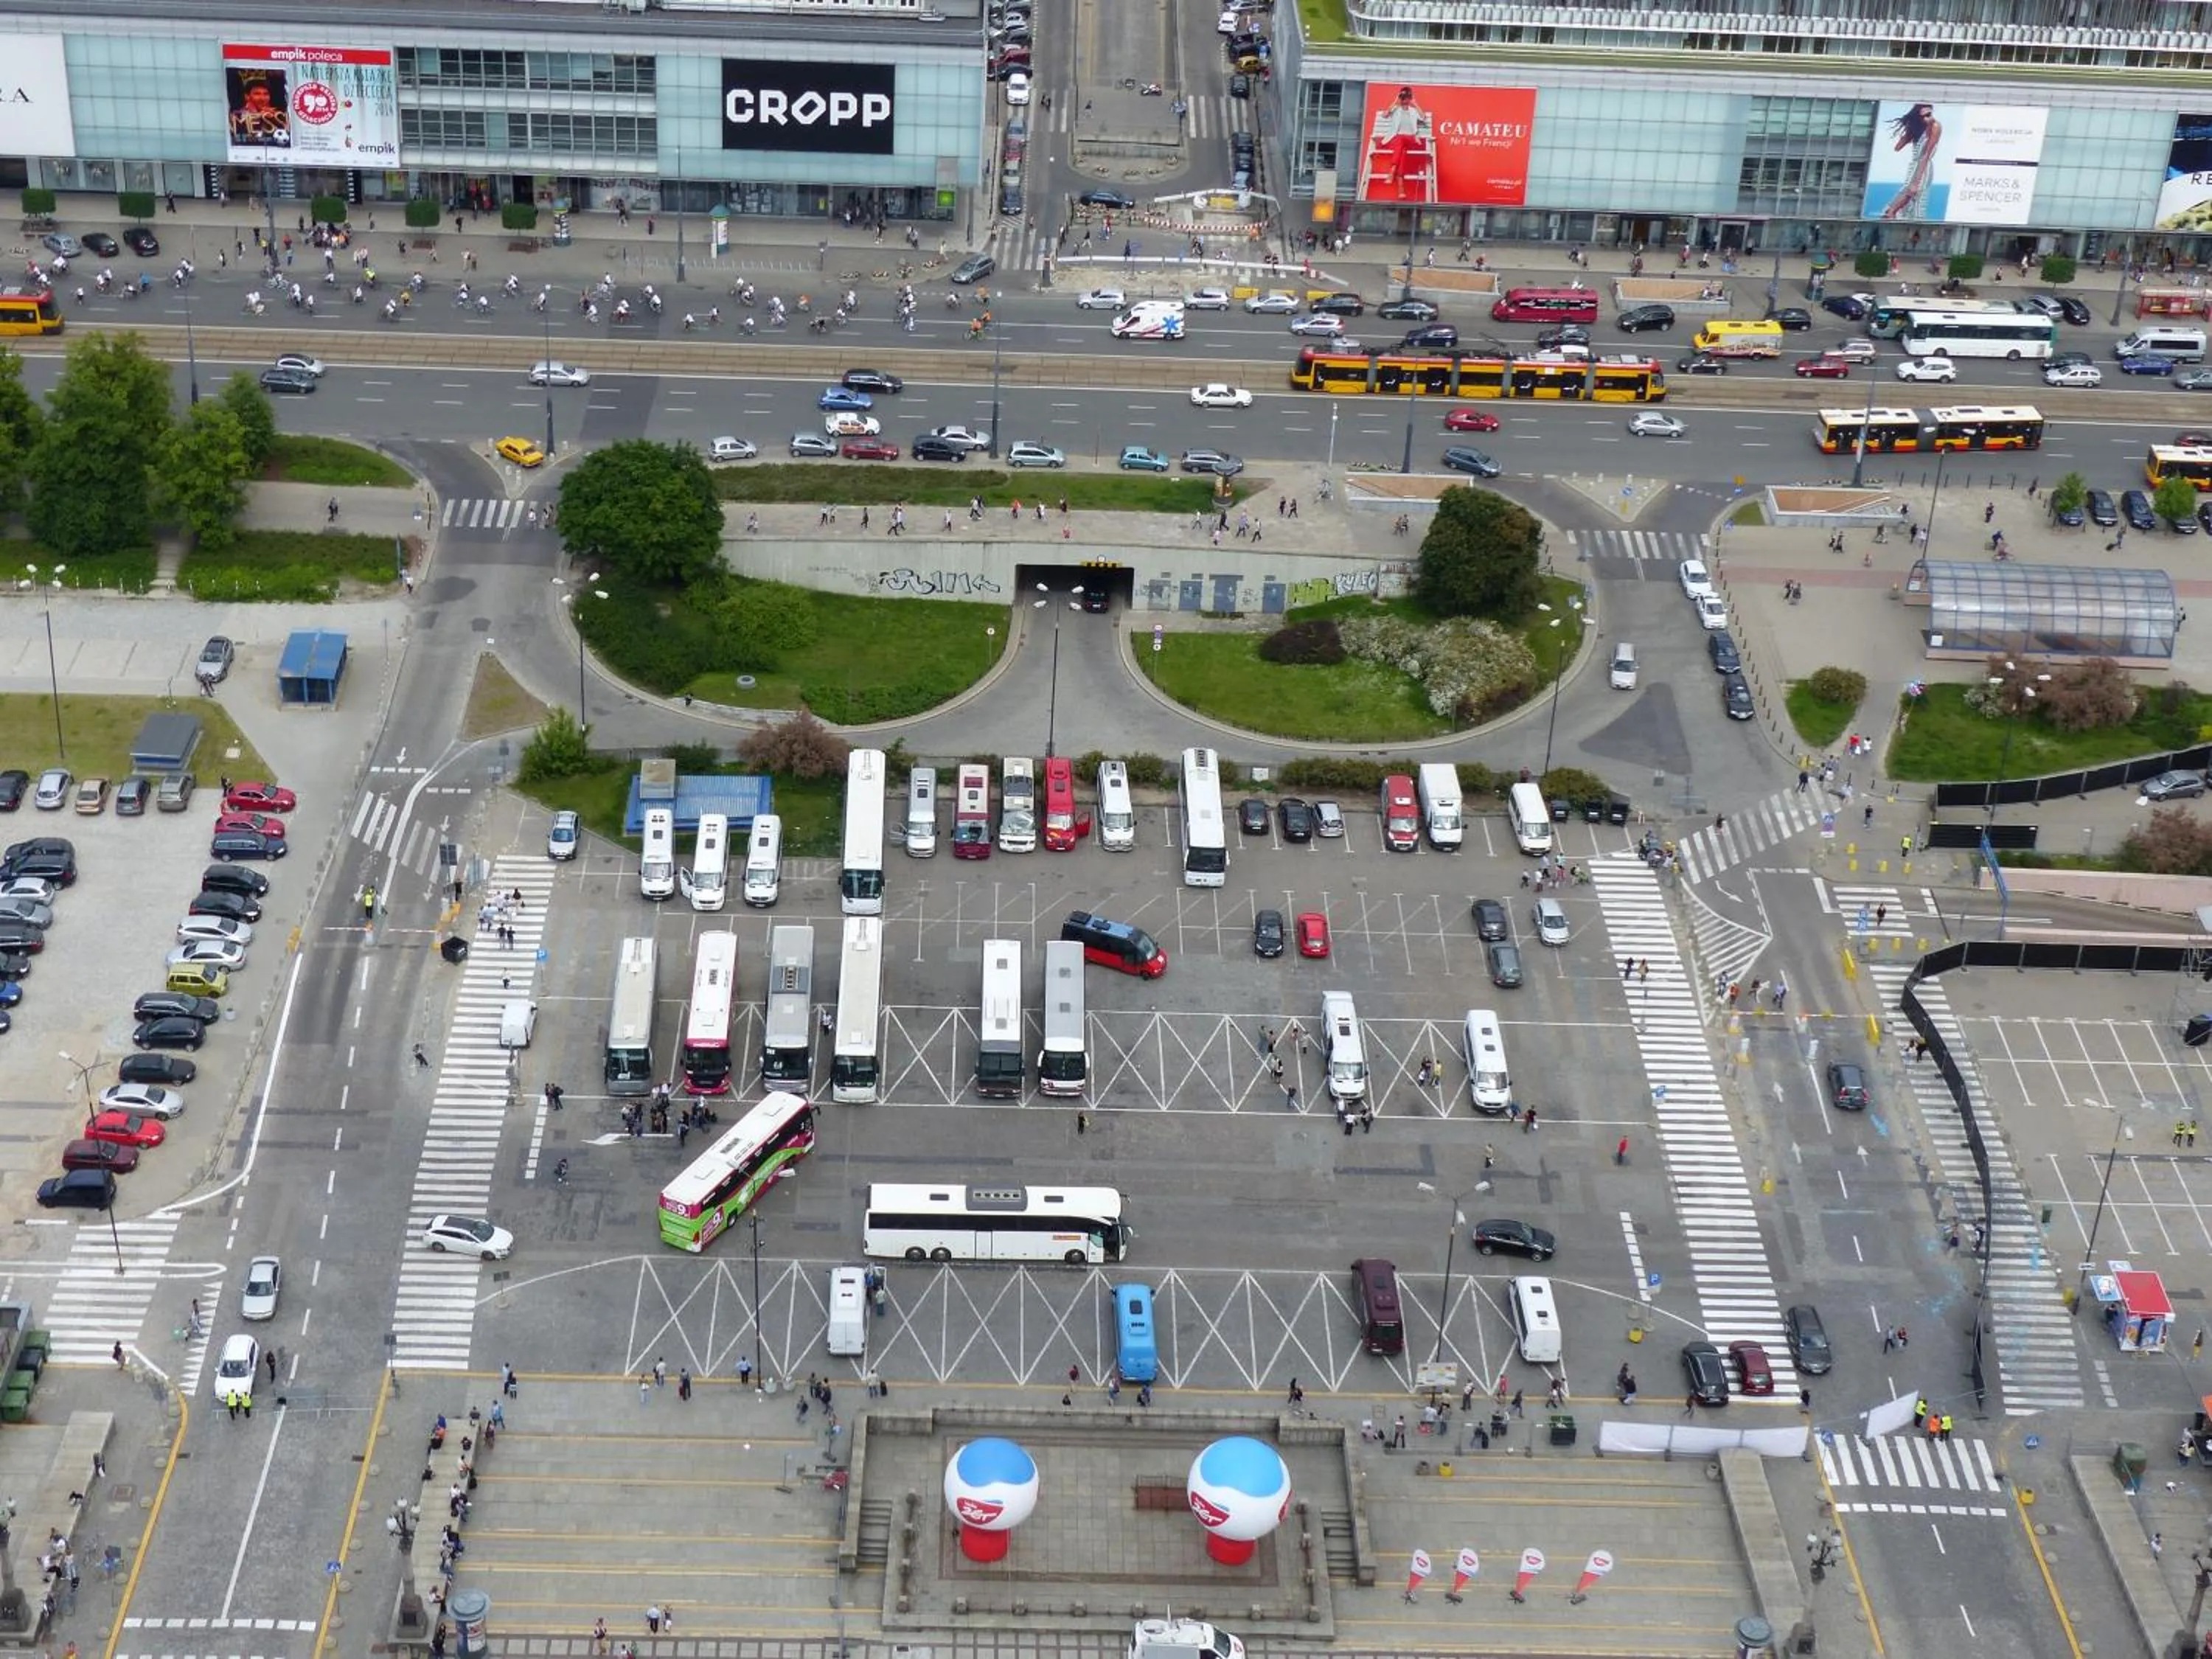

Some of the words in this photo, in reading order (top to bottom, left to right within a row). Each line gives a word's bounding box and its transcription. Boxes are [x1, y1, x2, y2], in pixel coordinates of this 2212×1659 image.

[271, 48, 306, 61] empik
[307, 50, 342, 63] poleca
[0, 87, 34, 103] A
[726, 89, 891, 128] CROPP
[358, 142, 395, 155] empik
[1959, 190, 2022, 204] SPENCER
